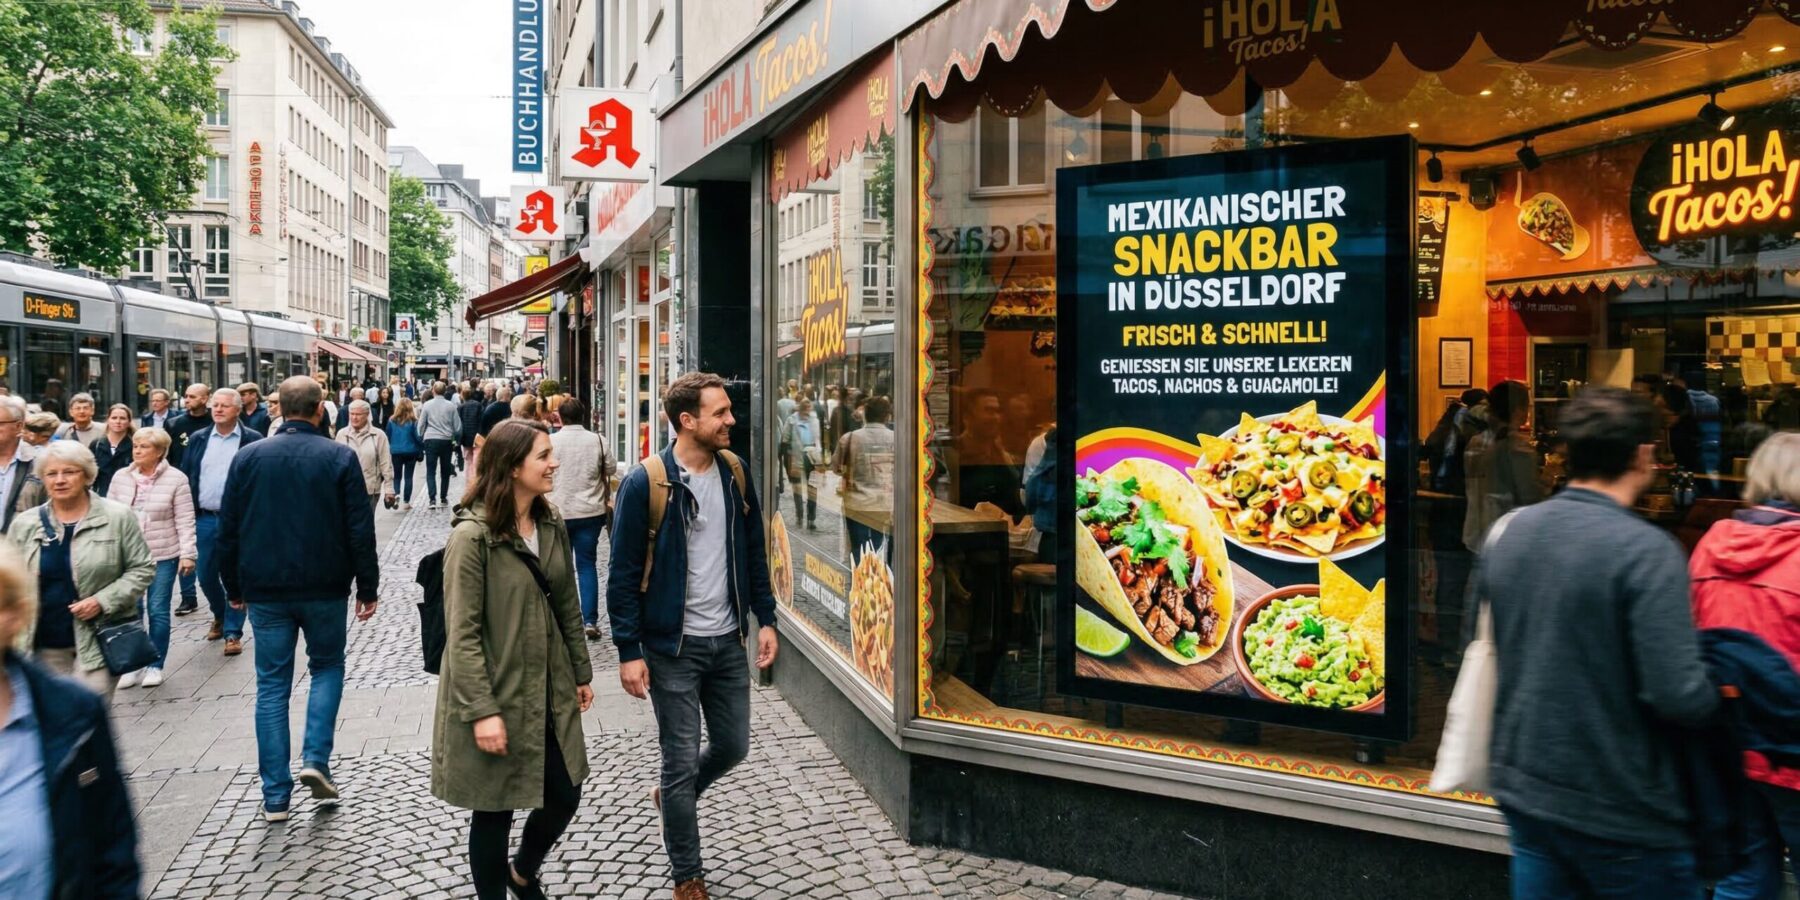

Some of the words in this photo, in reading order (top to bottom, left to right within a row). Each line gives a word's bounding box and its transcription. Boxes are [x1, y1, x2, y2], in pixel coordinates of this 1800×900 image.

[1228, 22, 1309, 65] Tacos!
[518, 0, 538, 165] BUCHHANDLU
[703, 62, 752, 148] ¡HOLA
[754, 0, 832, 113] Tacos!
[1671, 129, 1787, 185] ¡HOLA
[1107, 185, 1346, 232] MEXIKANISCHER
[1648, 159, 1800, 243] Tacos!
[809, 249, 842, 305] ¡HOLA
[1113, 222, 1339, 277] SNACKBAR
[1108, 282, 1136, 311] IN
[1144, 271, 1346, 310] DÜSSELDORF
[801, 291, 848, 374] Tacos!
[1123, 323, 1196, 347] FRISCH
[1201, 323, 1217, 345] &
[1222, 320, 1327, 344] SCHNELL!
[1100, 358, 1181, 375] GENIESSEN
[1184, 358, 1210, 374] SIE
[1213, 357, 1275, 373] UNSERE
[1278, 355, 1352, 373] LEKEREN
[1113, 377, 1161, 395] TACOS,
[1164, 377, 1223, 393] NACHOS
[1226, 377, 1238, 393] &
[1242, 376, 1339, 393] GUACAMOLE!
